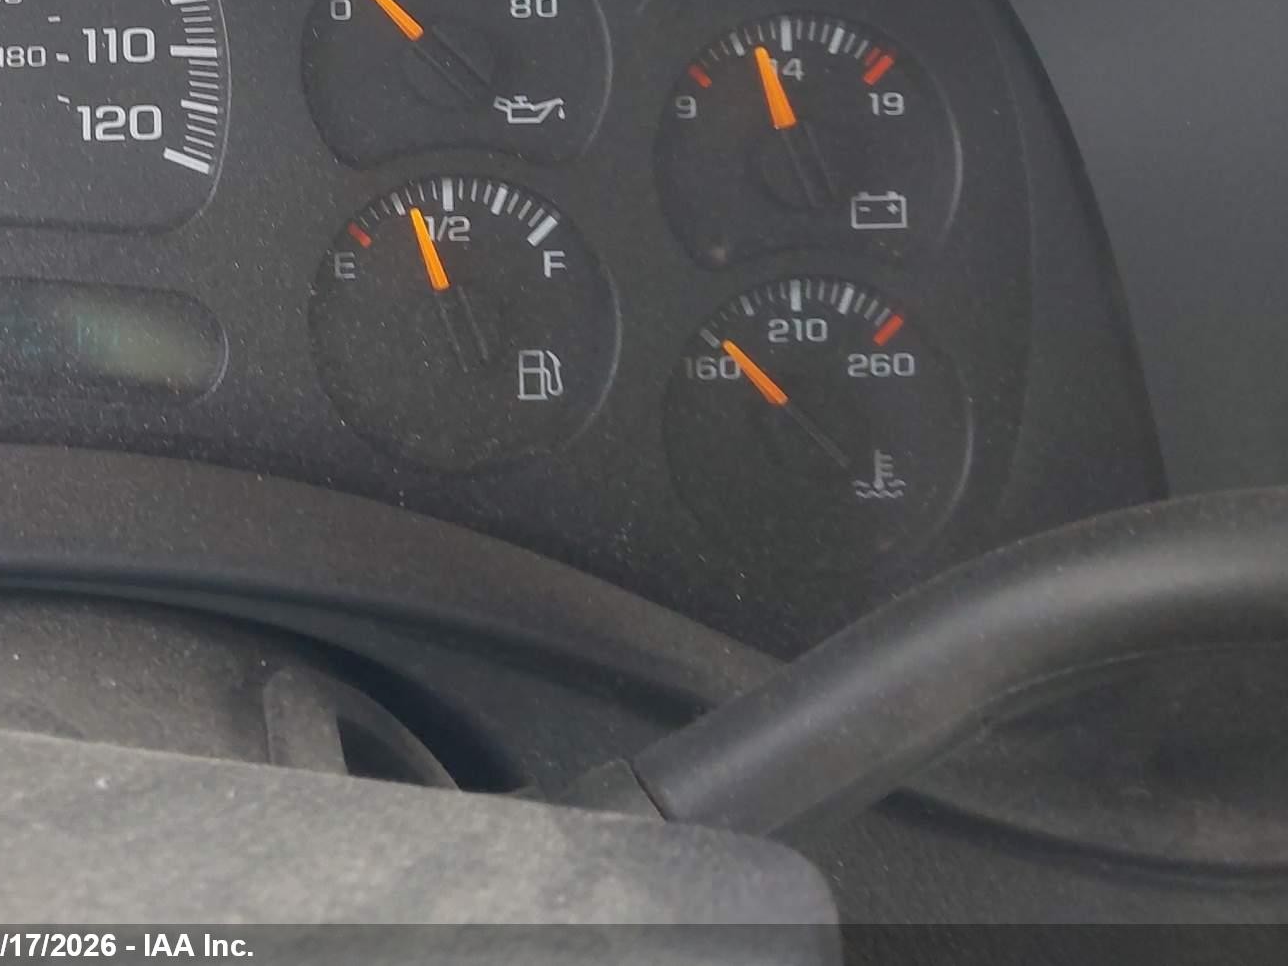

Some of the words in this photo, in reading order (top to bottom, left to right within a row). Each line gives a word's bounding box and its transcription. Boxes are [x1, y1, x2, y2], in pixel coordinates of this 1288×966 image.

[330, 0, 351, 21] 0
[82, 27, 155, 63] 110
[676, 96, 696, 120] 9
[869, 92, 904, 116] 19
[77, 105, 162, 141] 120
[424, 216, 471, 242] 1/2
[334, 253, 356, 279] E
[543, 250, 566, 277] F
[768, 319, 827, 342] 210
[681, 356, 741, 380] 160
[848, 353, 914, 377] 260
